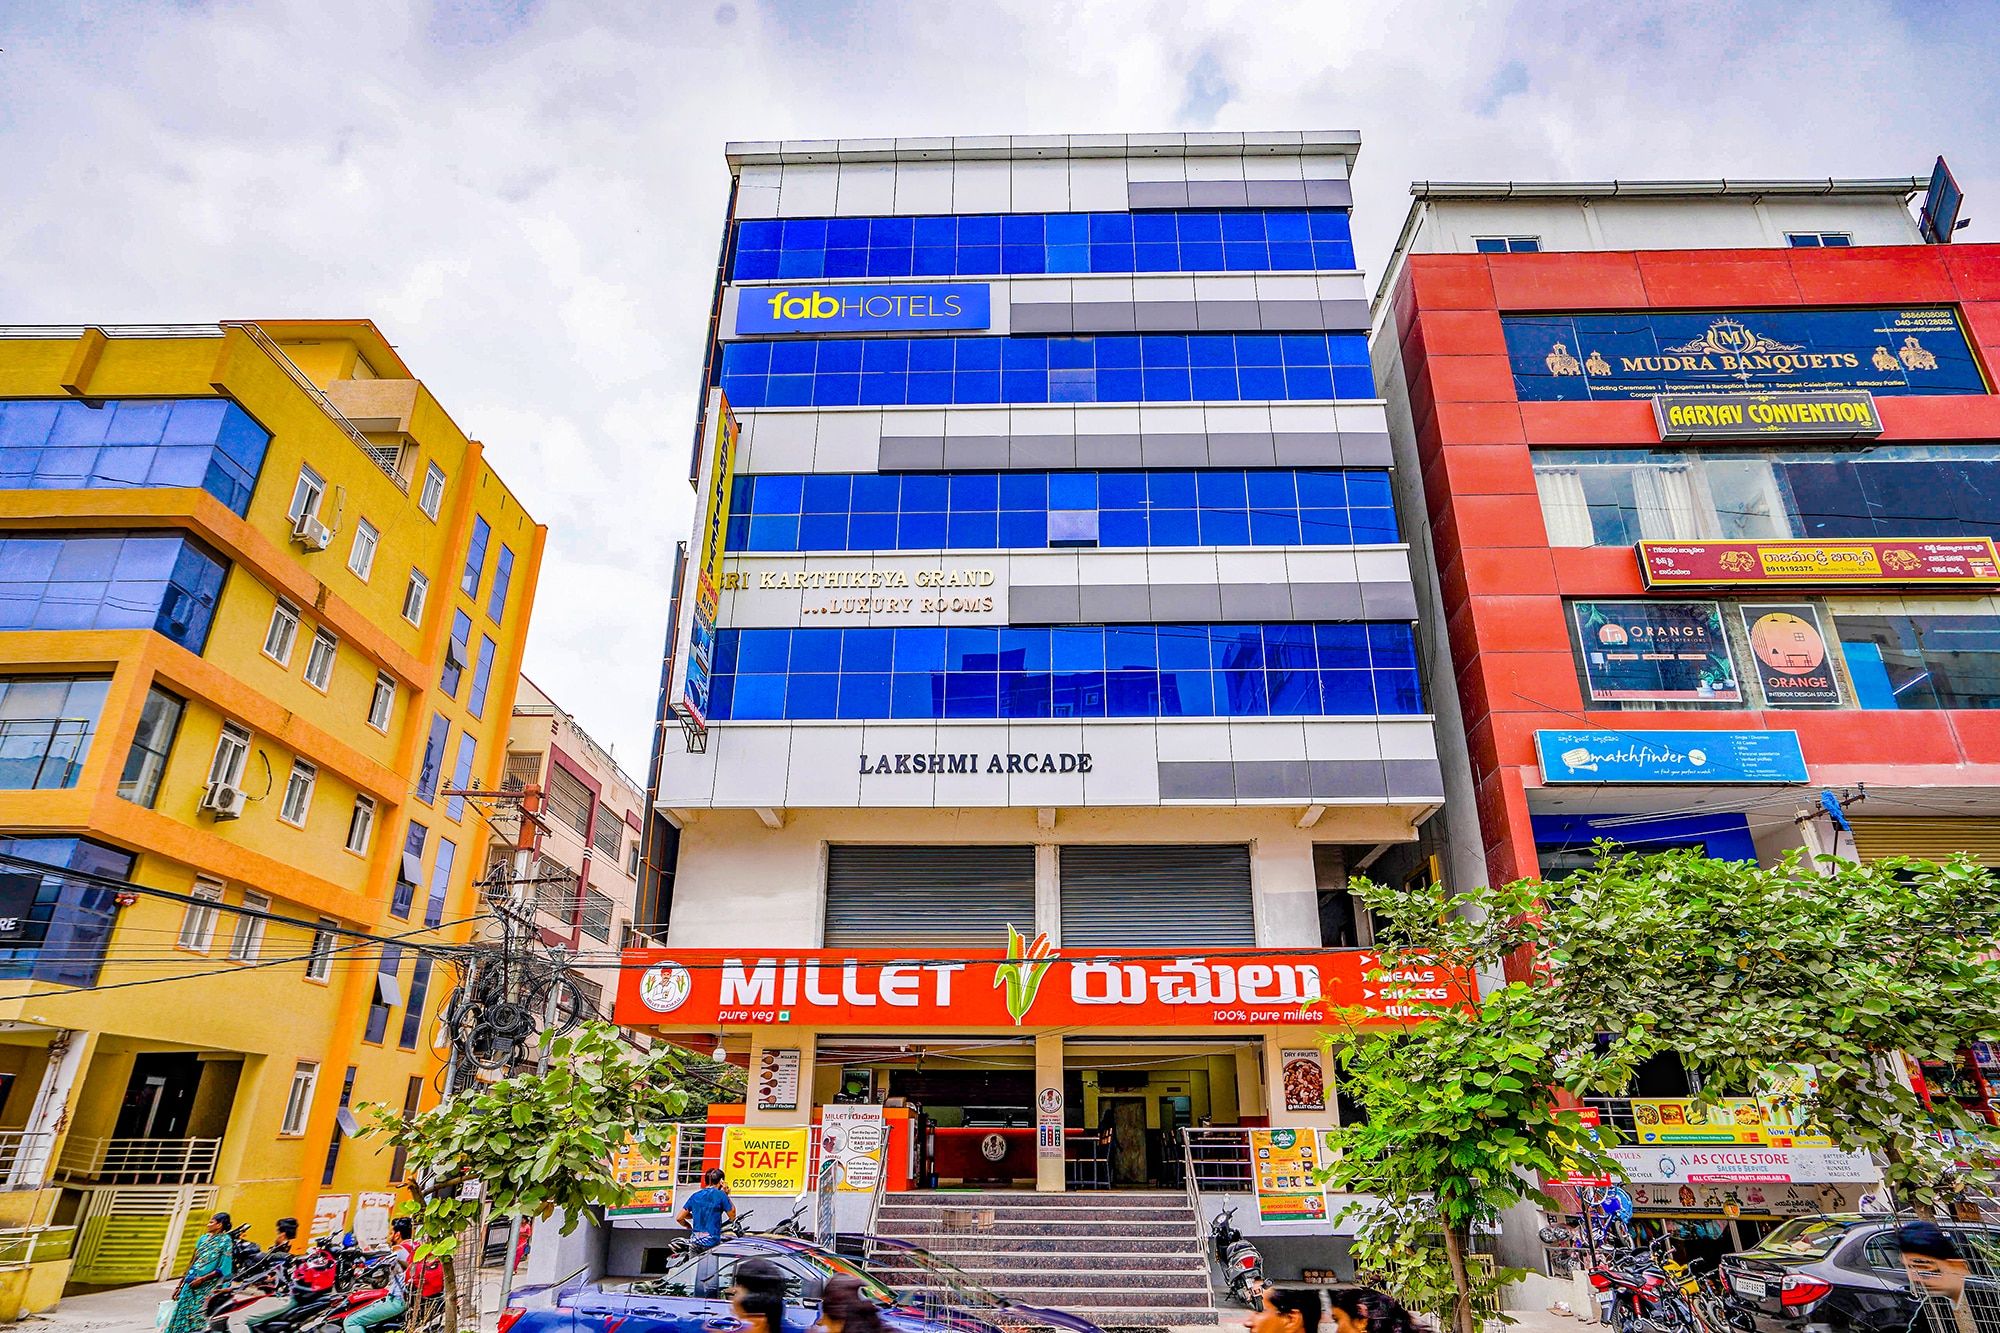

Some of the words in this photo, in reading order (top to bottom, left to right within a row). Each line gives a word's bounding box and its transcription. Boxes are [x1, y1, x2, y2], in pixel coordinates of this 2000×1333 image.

[1620, 356, 1718, 372] MUDRA
[1720, 353, 1859, 373] BANQUETS
[1669, 404, 1743, 427] AARYAV
[1748, 402, 1872, 424] CONVENTION
[1831, 550, 1874, 566] బిర్యాని
[760, 570, 909, 588] KARTHIKEYA
[915, 569, 995, 588] GRAND
[921, 596, 994, 613] ROOMS
[1630, 626, 1704, 637] ORANGE
[1769, 677, 1828, 687] ORANGE
[859, 753, 978, 774] LAKSHMI
[986, 753, 1093, 774] ARCADE
[1590, 745, 1686, 768] matchfinder
[719, 958, 965, 1006] MILLET
[1071, 955, 1322, 1005] రుచులు
[718, 1010, 748, 1022] pure
[751, 1010, 774, 1022] veg
[1213, 1010, 1246, 1021] 100%
[1250, 1010, 1280, 1022] pure
[744, 1141, 790, 1149] WANTED
[733, 1151, 798, 1169] STAFF
[1693, 1154, 1708, 1164] AS
[1711, 1154, 1747, 1164] CYCLE
[1750, 1153, 1789, 1164] STORE
[733, 1179, 794, 1188] 6301799821
